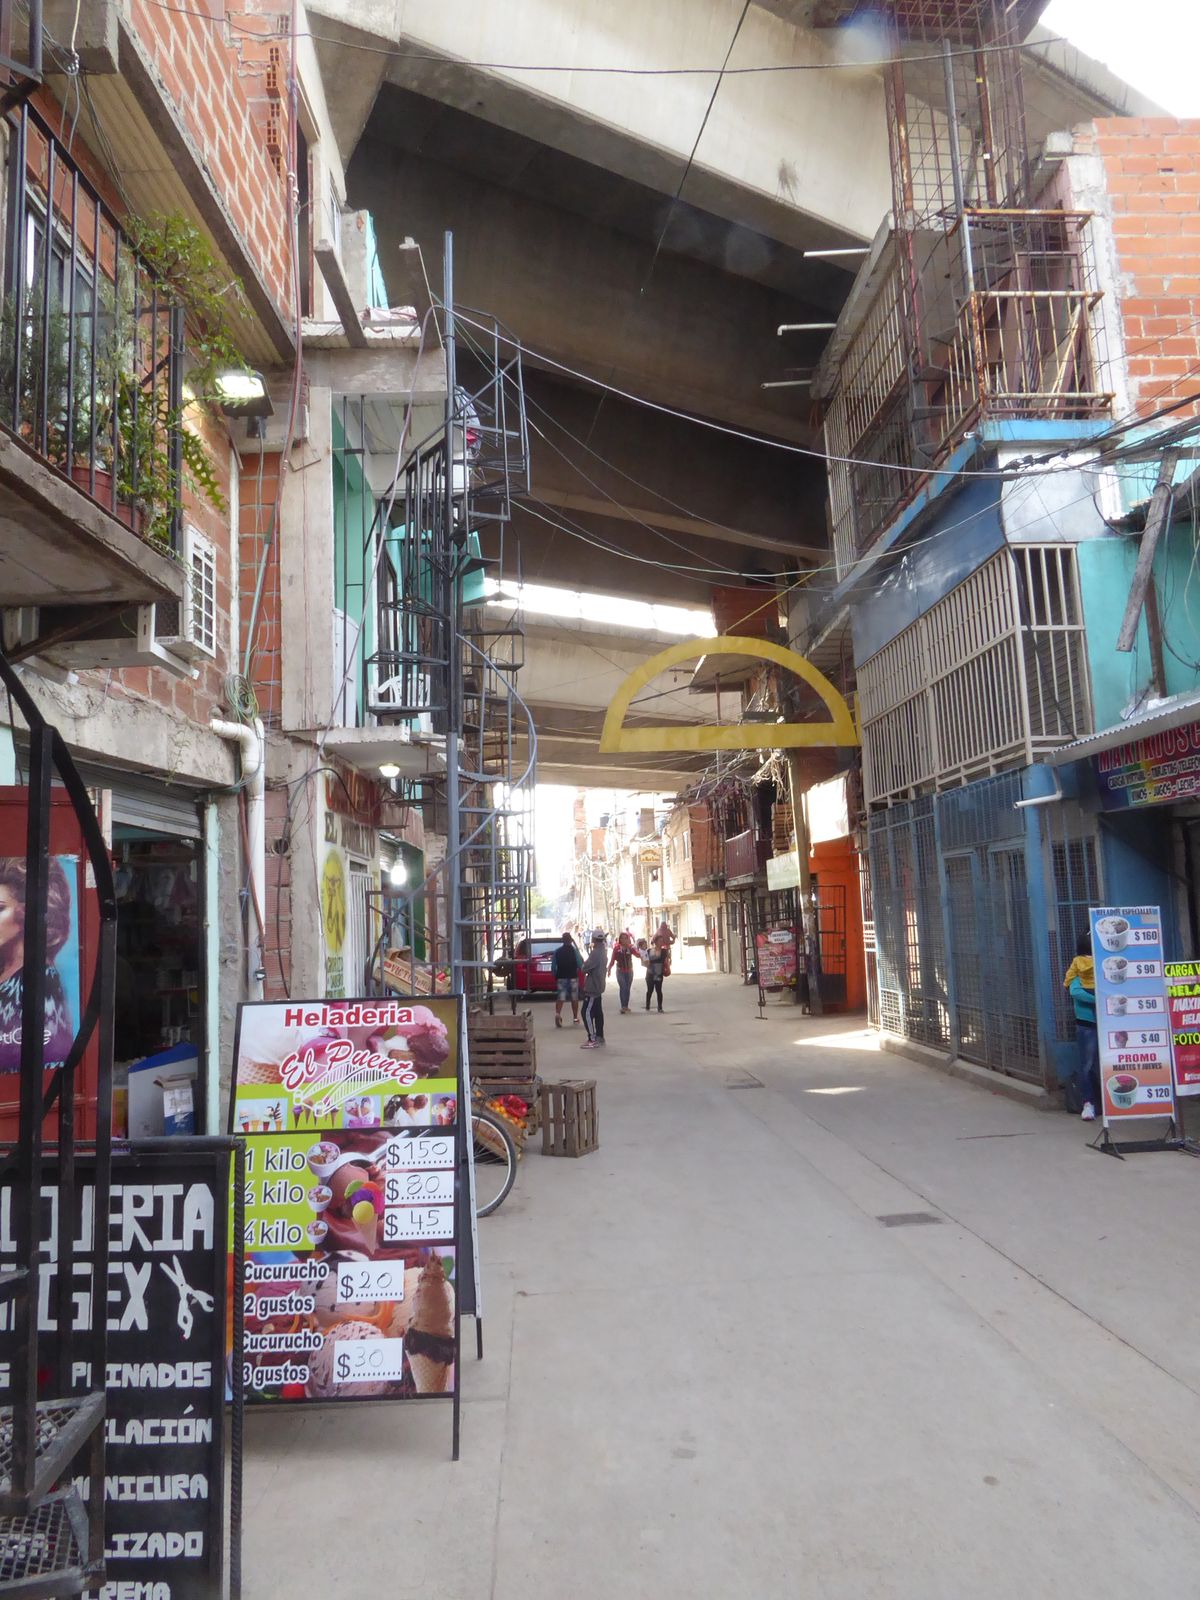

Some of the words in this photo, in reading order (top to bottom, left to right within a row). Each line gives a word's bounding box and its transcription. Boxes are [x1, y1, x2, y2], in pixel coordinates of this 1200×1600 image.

[1144, 964, 1155, 975] 90
[1164, 963, 1194, 978] CARGA
[284, 1000, 413, 1027] Heladeria
[1145, 999, 1157, 1010] 50
[1149, 1033, 1160, 1043] 40
[281, 1049, 316, 1089] El
[326, 1040, 417, 1085] Puente
[1118, 1052, 1157, 1063] PROMO
[1154, 1087, 1170, 1098] 120
[245, 1149, 254, 1172] 1
[265, 1148, 307, 1172] kilo
[263, 1180, 304, 1204] kilo
[260, 1220, 302, 1244] kilo
[244, 1261, 328, 1281] Cucurucho
[244, 1295, 255, 1314] 2
[259, 1293, 314, 1318] gustos
[255, 1362, 308, 1387] gustos
